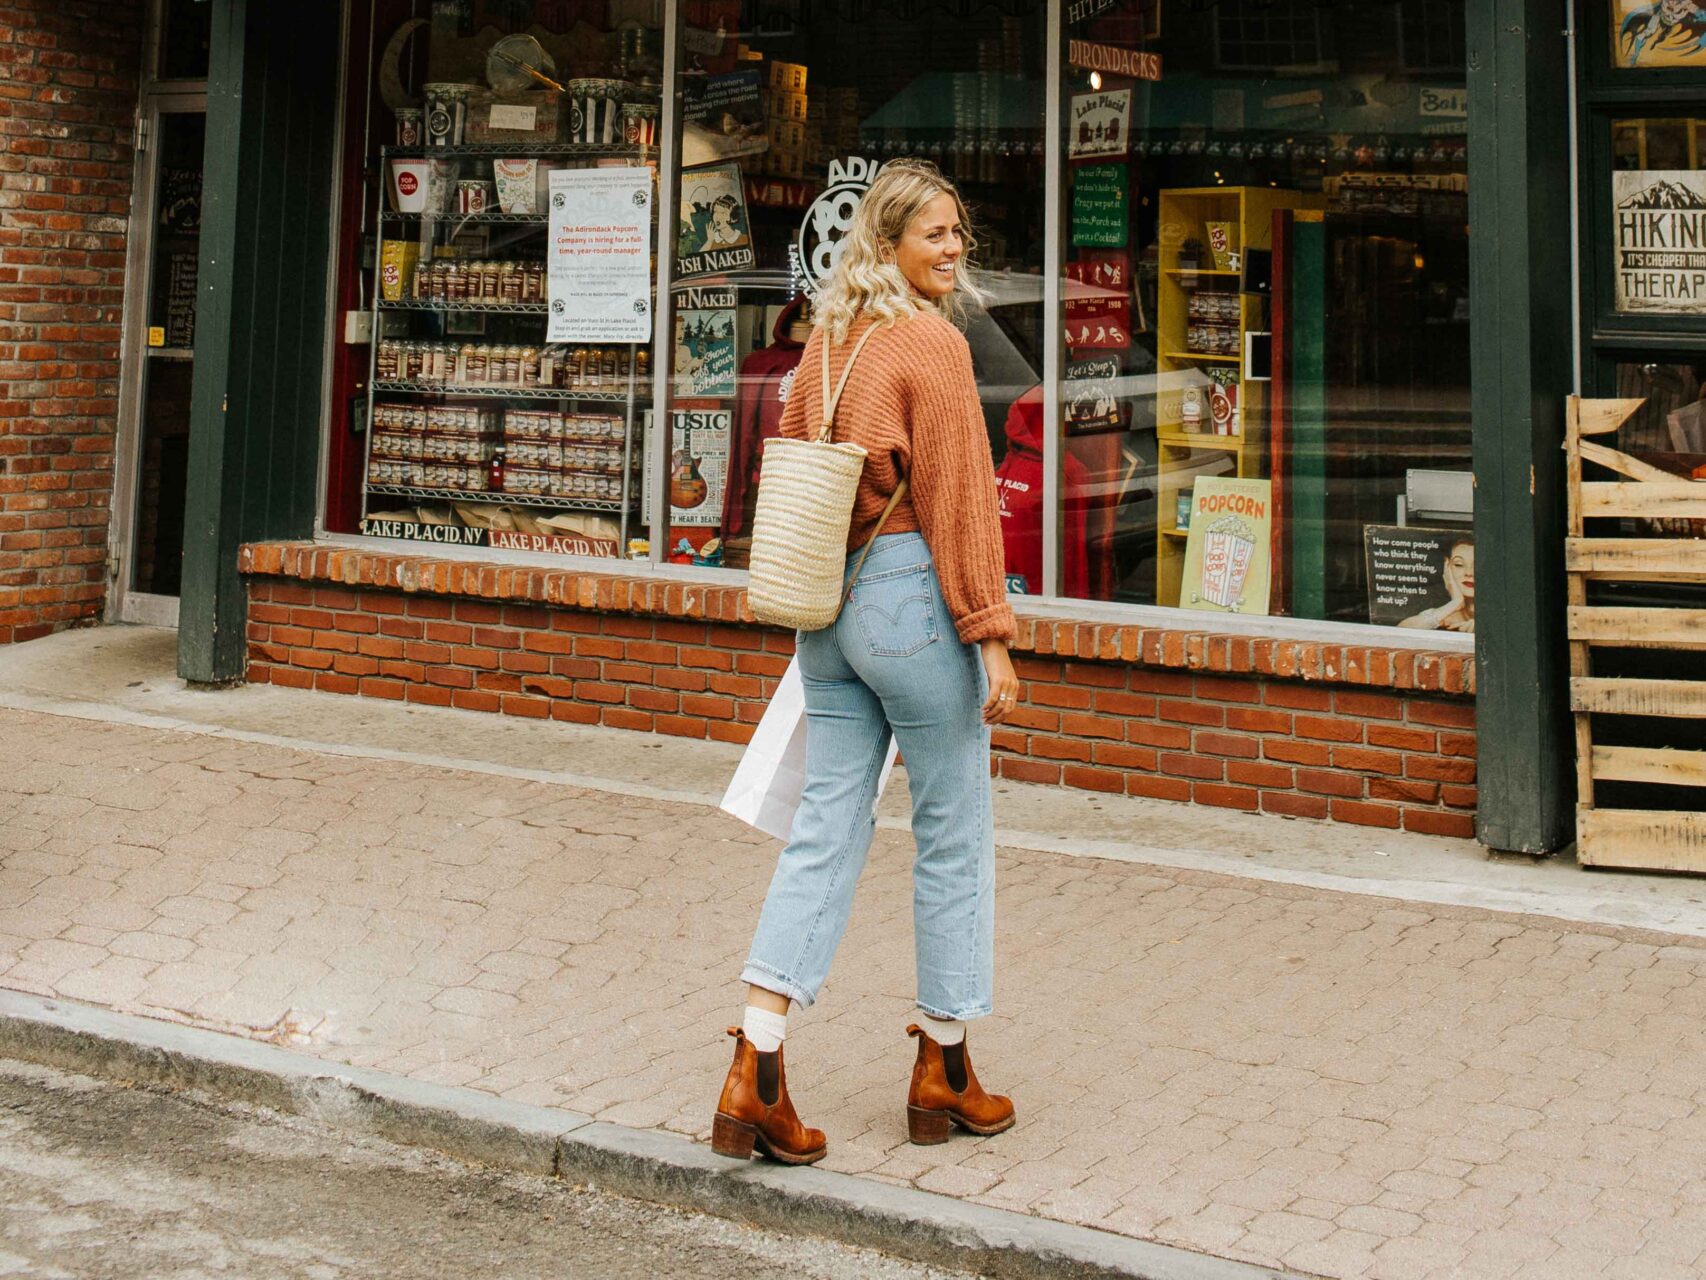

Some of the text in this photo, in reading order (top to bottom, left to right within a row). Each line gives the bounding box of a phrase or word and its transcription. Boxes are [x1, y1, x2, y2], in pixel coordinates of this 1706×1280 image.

[1069, 40, 1158, 80] DIRONDACKS
[684, 111, 707, 121] tioned
[1076, 96, 1126, 119] Lake Placid
[812, 191, 862, 242] PO
[612, 225, 638, 233] Popcorn
[1211, 229, 1224, 240] POP
[594, 236, 614, 244] hiring
[677, 248, 752, 274] ISH NAKED
[788, 243, 804, 279] LAKE
[1627, 252, 1706, 268] IT'S CHEAPER THA
[1620, 272, 1706, 299] THERAP
[687, 287, 736, 309] NAKED
[704, 346, 730, 363] Show
[712, 353, 734, 372] your
[1067, 362, 1109, 379] Let's Sleep
[692, 367, 735, 395] bobbers
[778, 366, 799, 403] ADIRO
[1003, 479, 1030, 493] PLACID
[1199, 493, 1265, 520] POPCORN
[362, 519, 401, 538] LAKE
[700, 516, 721, 524] BEATIN
[489, 531, 530, 550] LAKE
[1372, 536, 1439, 550] How come people
[1208, 553, 1224, 561] POP
[1373, 548, 1428, 562] who think they
[1374, 560, 1437, 574] know everything,
[1375, 573, 1428, 583] never seem to
[1375, 583, 1428, 595] know when to
[1376, 595, 1408, 607] shut up?
